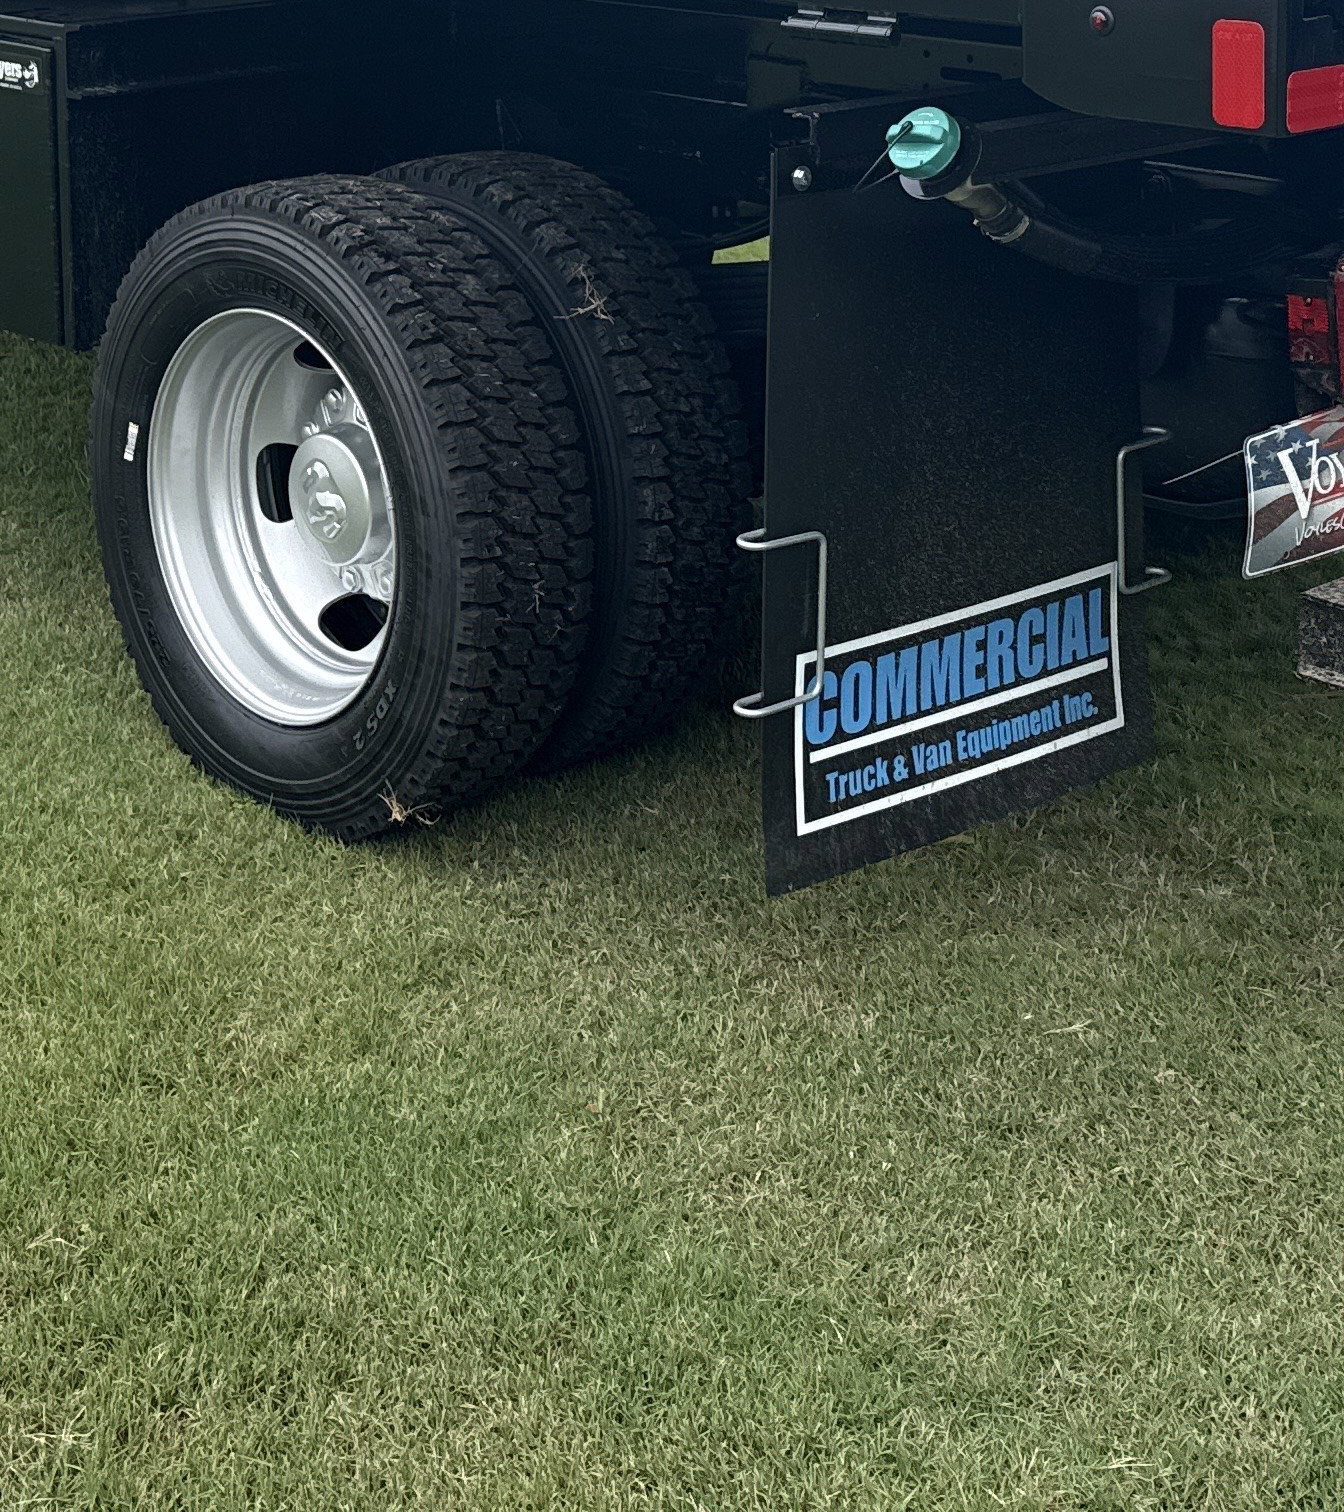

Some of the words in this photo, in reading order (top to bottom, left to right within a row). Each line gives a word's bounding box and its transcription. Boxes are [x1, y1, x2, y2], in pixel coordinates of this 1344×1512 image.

[805, 588, 1110, 745] COMMERCIAL
[825, 756, 889, 804] Truck
[893, 755, 909, 782] &
[911, 739, 954, 776] Van
[956, 699, 1061, 762] Equipment
[1063, 691, 1099, 725] Inc.
